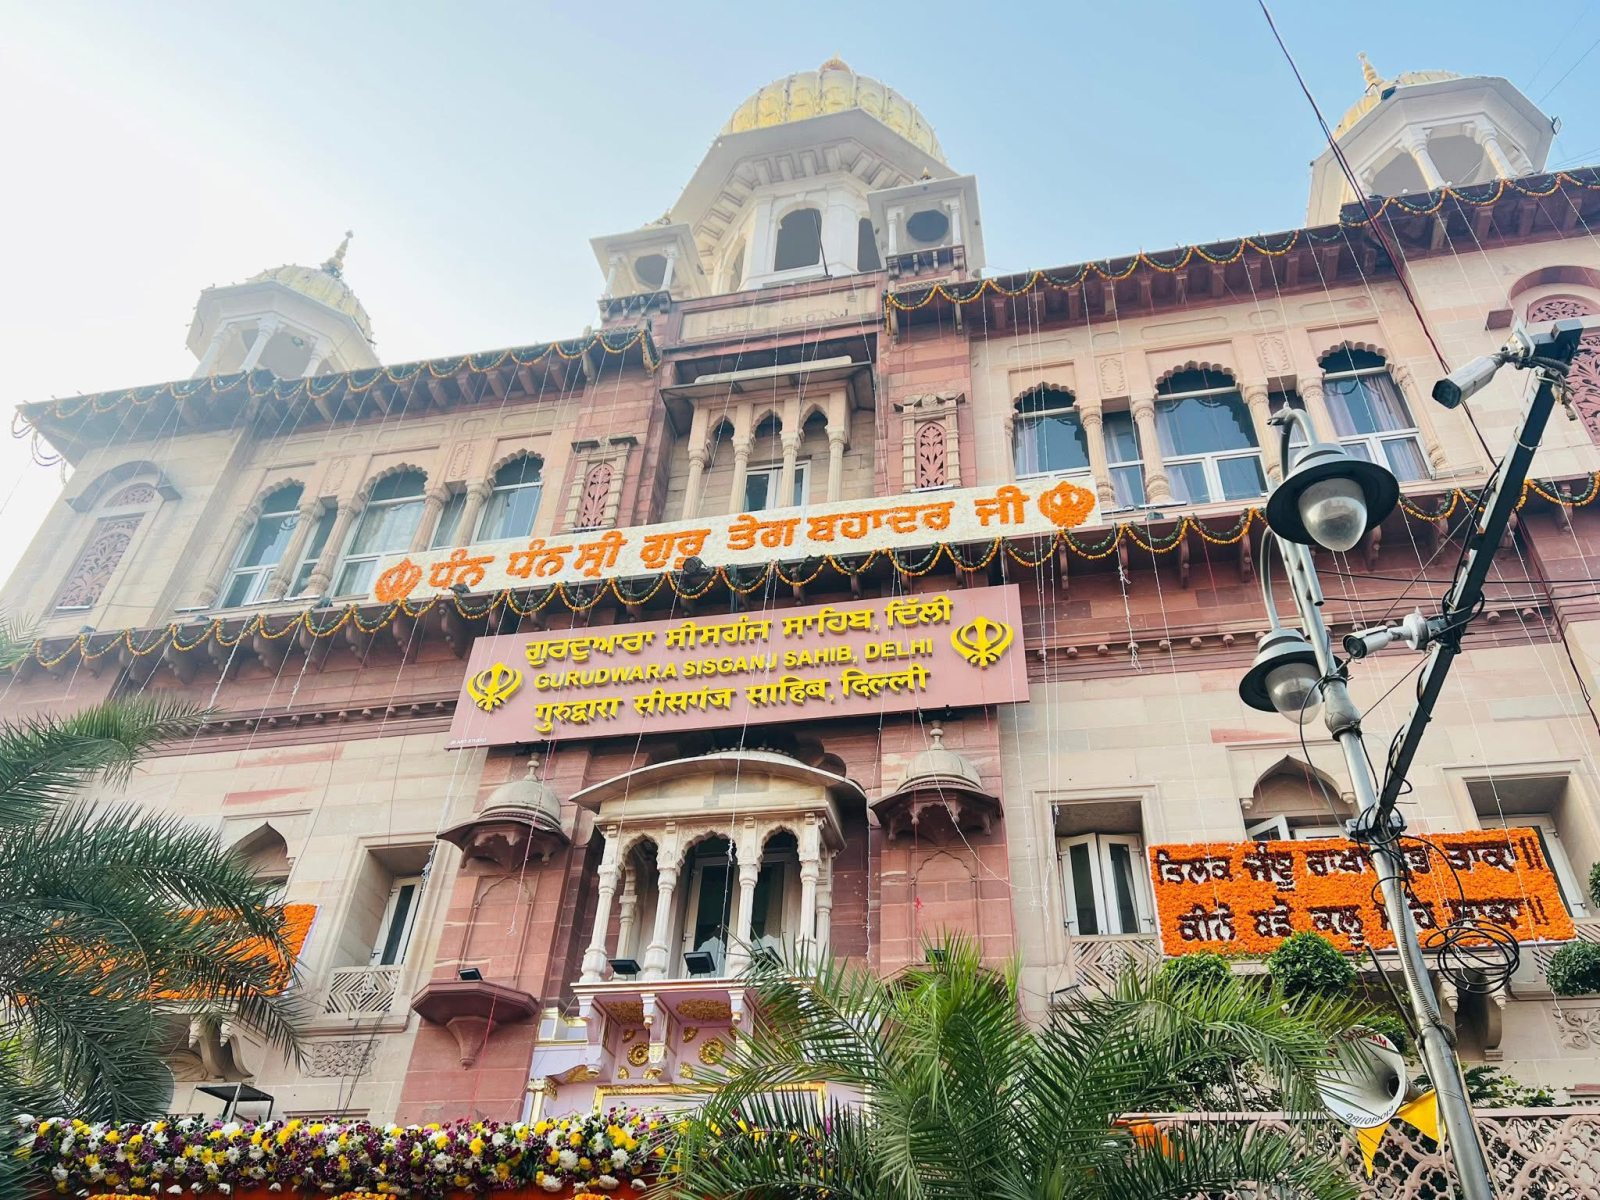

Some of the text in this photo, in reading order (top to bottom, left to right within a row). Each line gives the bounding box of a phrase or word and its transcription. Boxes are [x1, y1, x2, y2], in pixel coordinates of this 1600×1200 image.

[727, 514, 802, 551] ਤੇਗ
[806, 501, 956, 543] ਬਹਾਦਰ
[974, 485, 1030, 527] ਜੀ
[525, 631, 657, 667] ਗੁਰਦੁਆਰਾ
[665, 615, 773, 650] ਸੀਸਗੰਜ
[884, 594, 954, 629] ਦਿੱਲੀ
[533, 638, 935, 690] GURUDWARA SISGANJ SAHIB, DELHI
[632, 685, 738, 717] सीसगंज
[839, 662, 931, 699] दिल्ली
